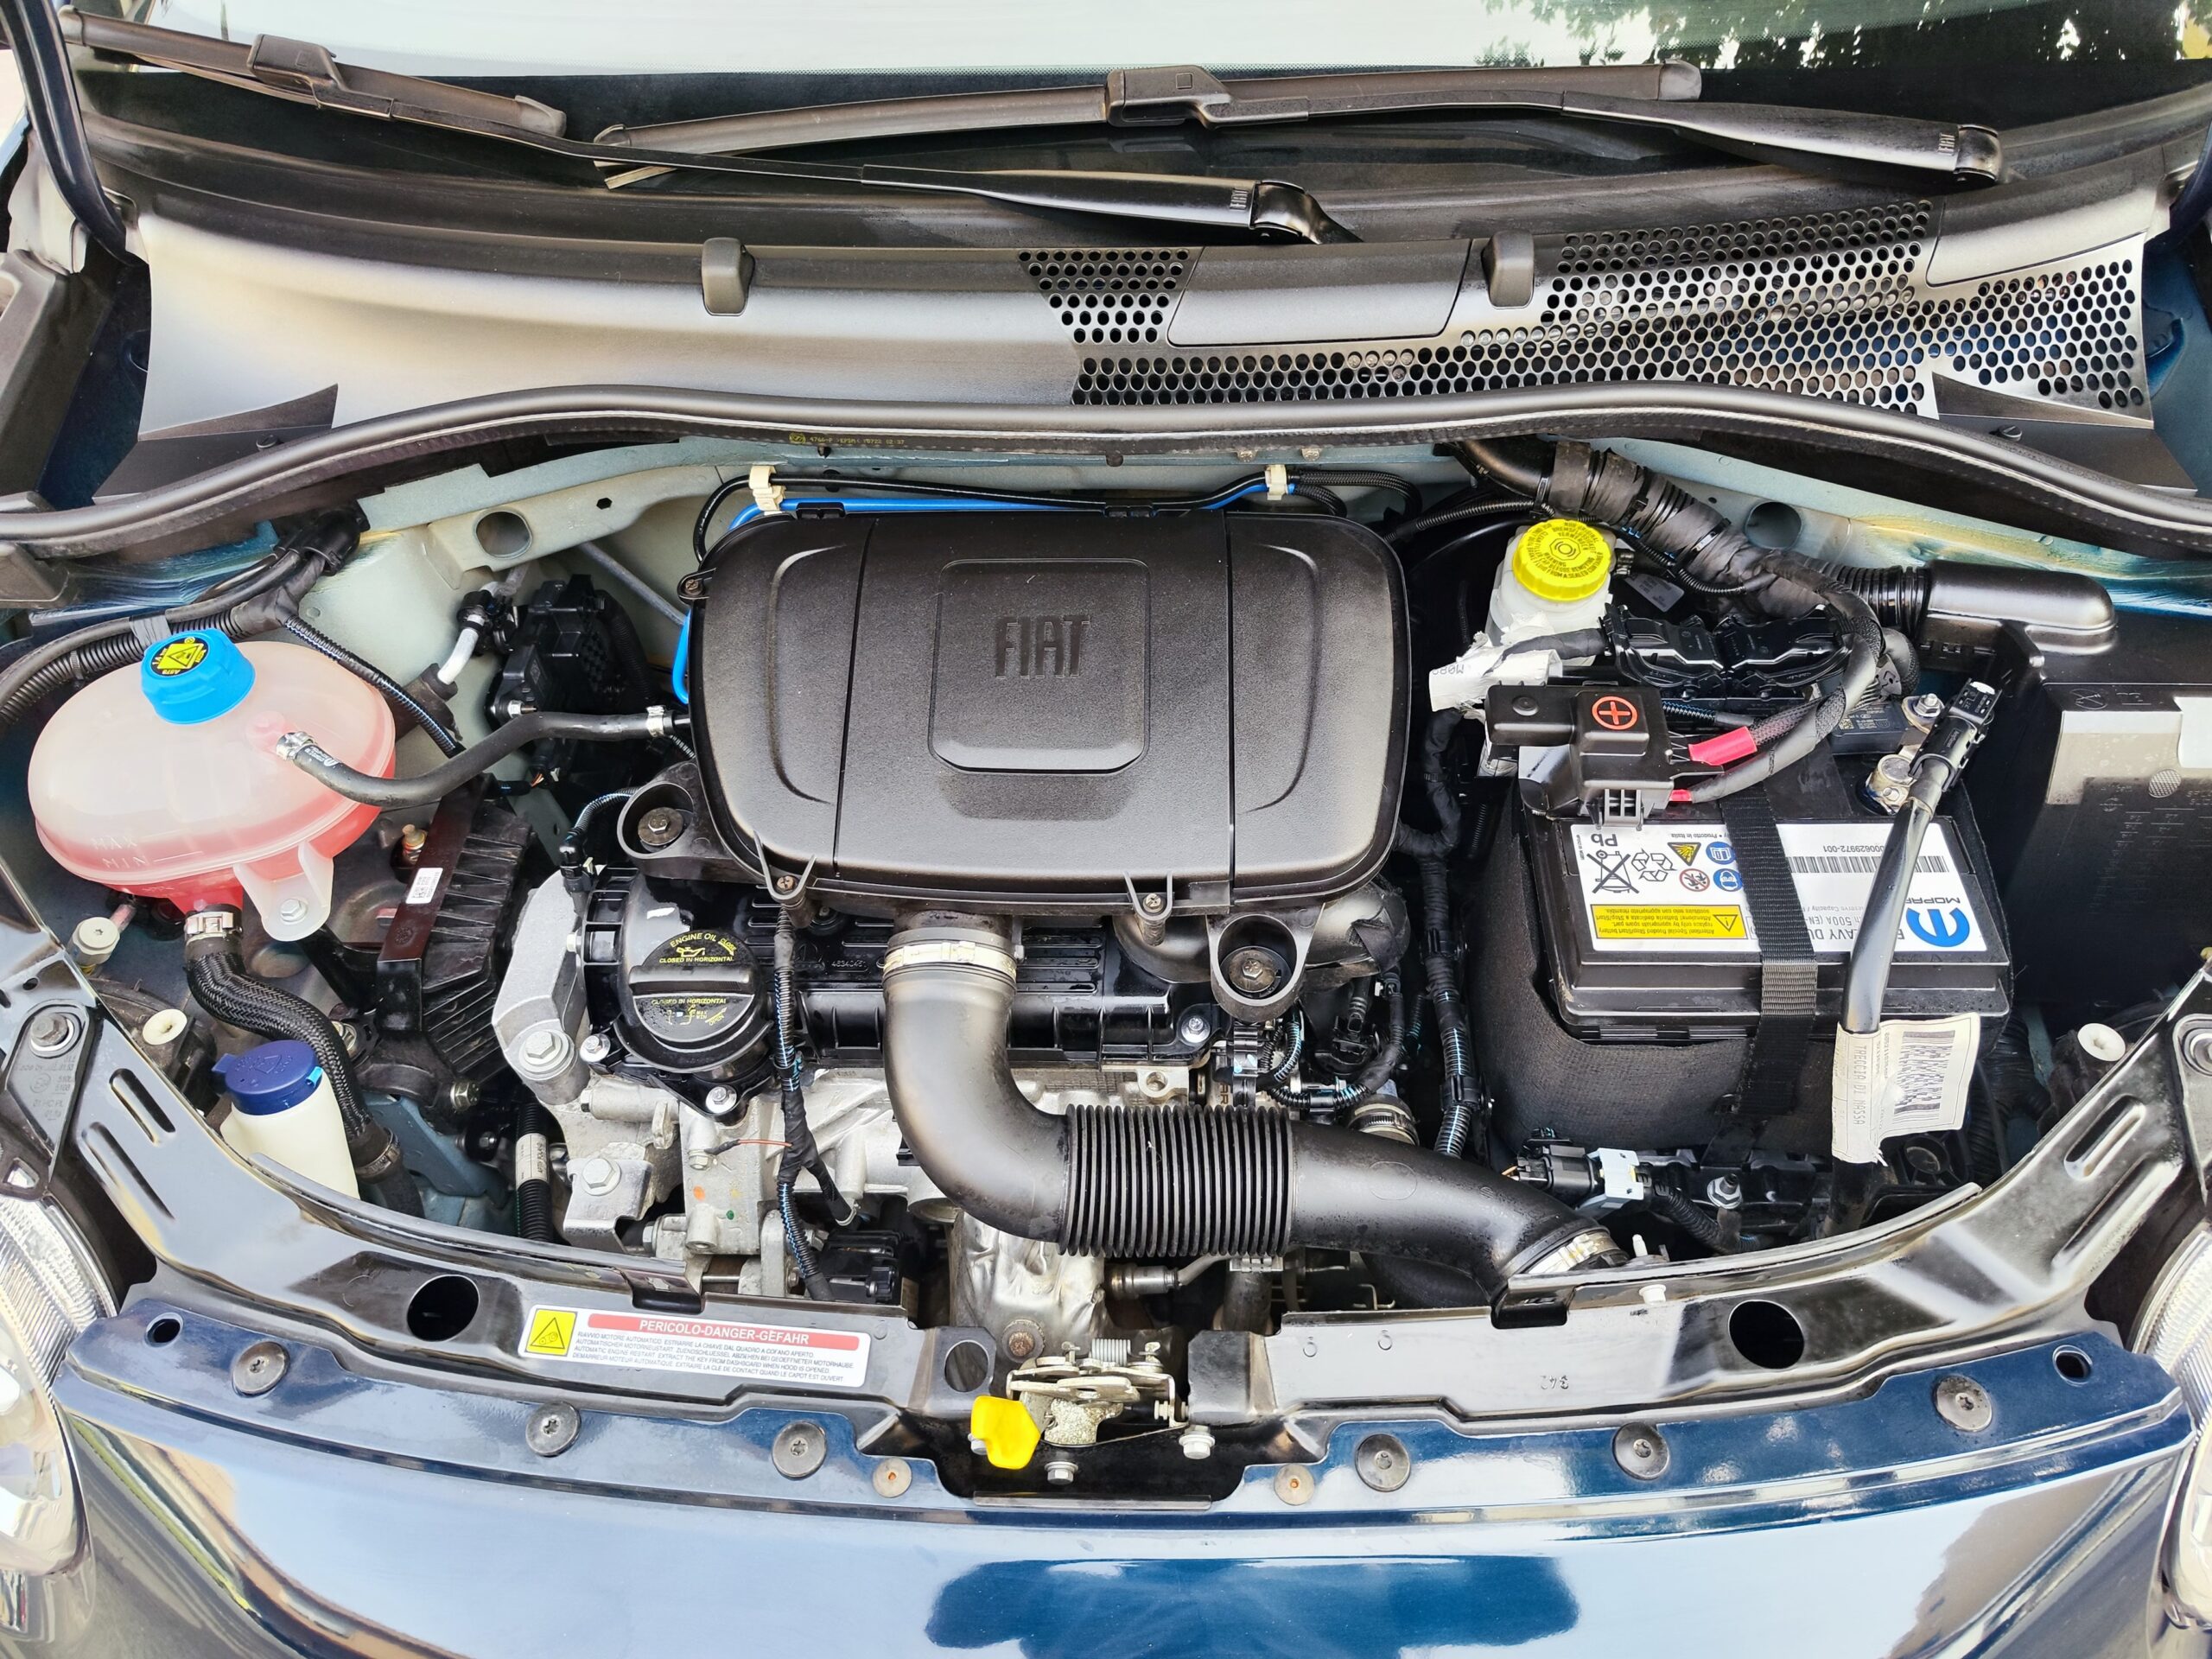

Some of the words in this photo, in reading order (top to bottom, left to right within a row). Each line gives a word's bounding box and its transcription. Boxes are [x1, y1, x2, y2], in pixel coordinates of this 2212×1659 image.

[995, 614, 1090, 679] FIAT
[1591, 834, 1618, 846] Pb
[1826, 915, 1852, 925] 500A
[670, 932, 702, 948] ENGINE
[704, 933, 717, 942] OIL
[720, 938, 737, 951] CLOSE
[709, 1014, 725, 1027] OPEN
[1853, 1082, 1866, 1095] DI
[1853, 1099, 1866, 1125] MASSA
[639, 1319, 810, 1344] PERICOLO-DANGER-GEFAHR
